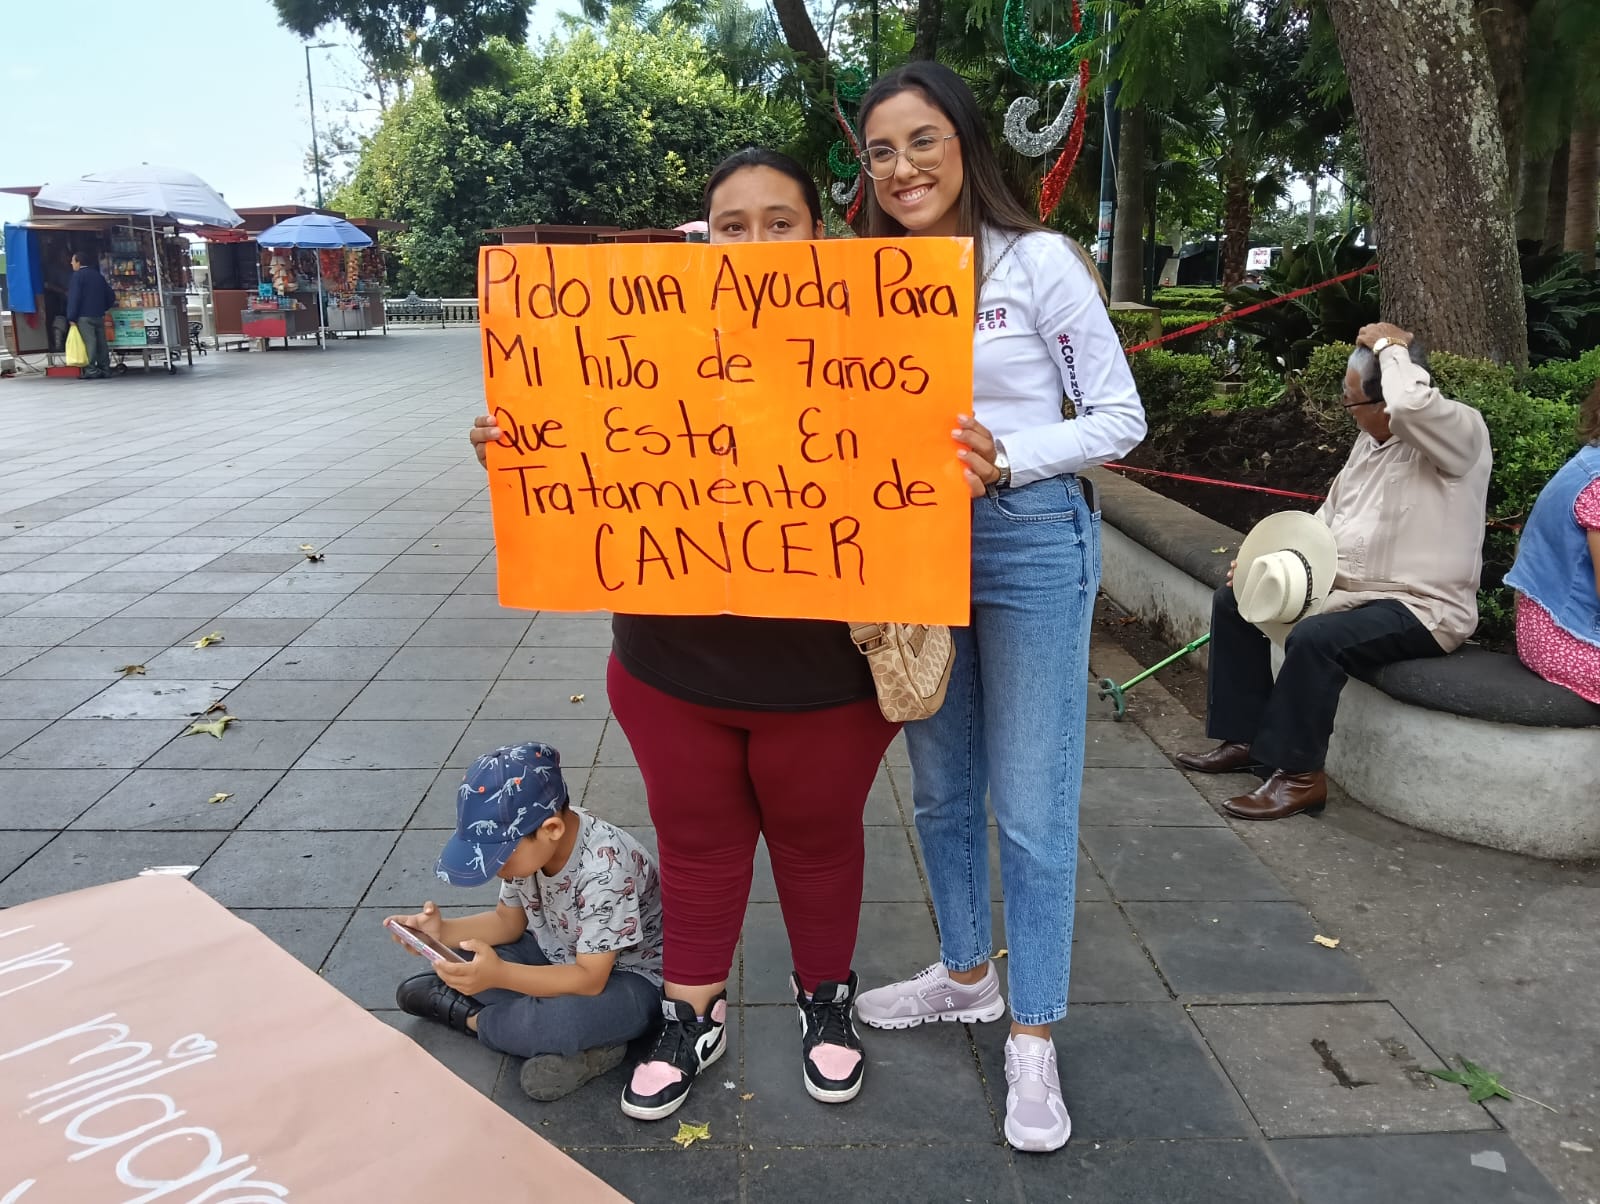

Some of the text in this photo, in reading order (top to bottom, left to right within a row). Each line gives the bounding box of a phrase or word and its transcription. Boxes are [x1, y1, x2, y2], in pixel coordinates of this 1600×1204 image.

[874, 246, 958, 317] Para
[975, 307, 1007, 324] FER
[696, 328, 755, 385] de
[1057, 333, 1085, 408] #Corazón
[604, 399, 738, 467] Esta
[799, 407, 859, 463] En
[873, 458, 938, 511] de
[595, 515, 865, 592] CANCER
